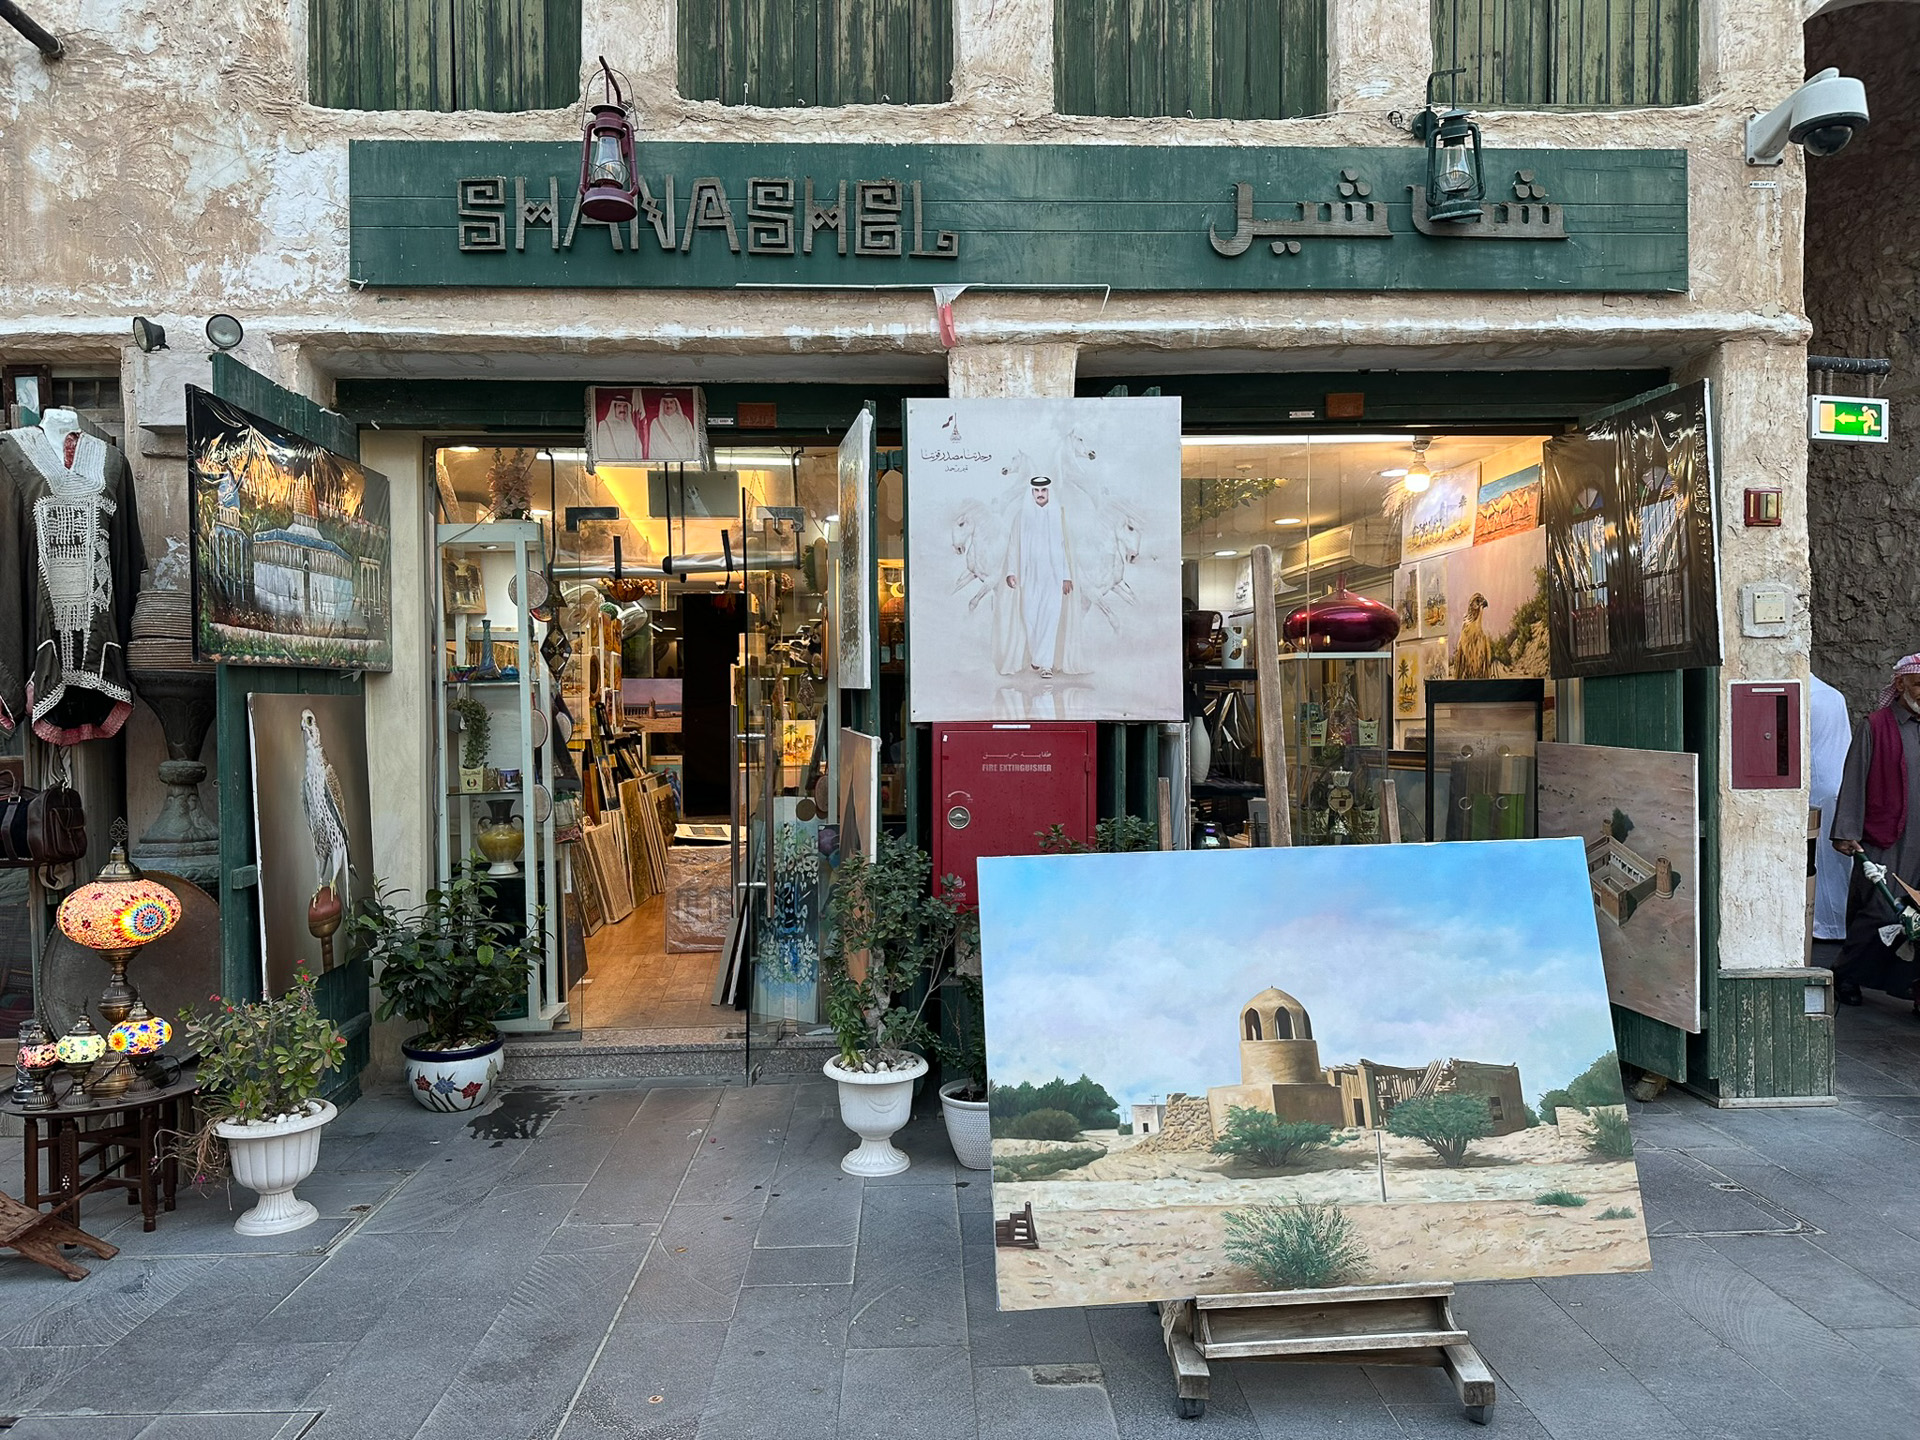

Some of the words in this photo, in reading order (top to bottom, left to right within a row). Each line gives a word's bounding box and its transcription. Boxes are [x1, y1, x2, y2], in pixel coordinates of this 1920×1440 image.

[457, 174, 959, 258] SHANASHEL
[963, 449, 993, 462] وحدتنا
[982, 764, 998, 772] FIRE
[999, 764, 1052, 772] EXTINGUISHER
